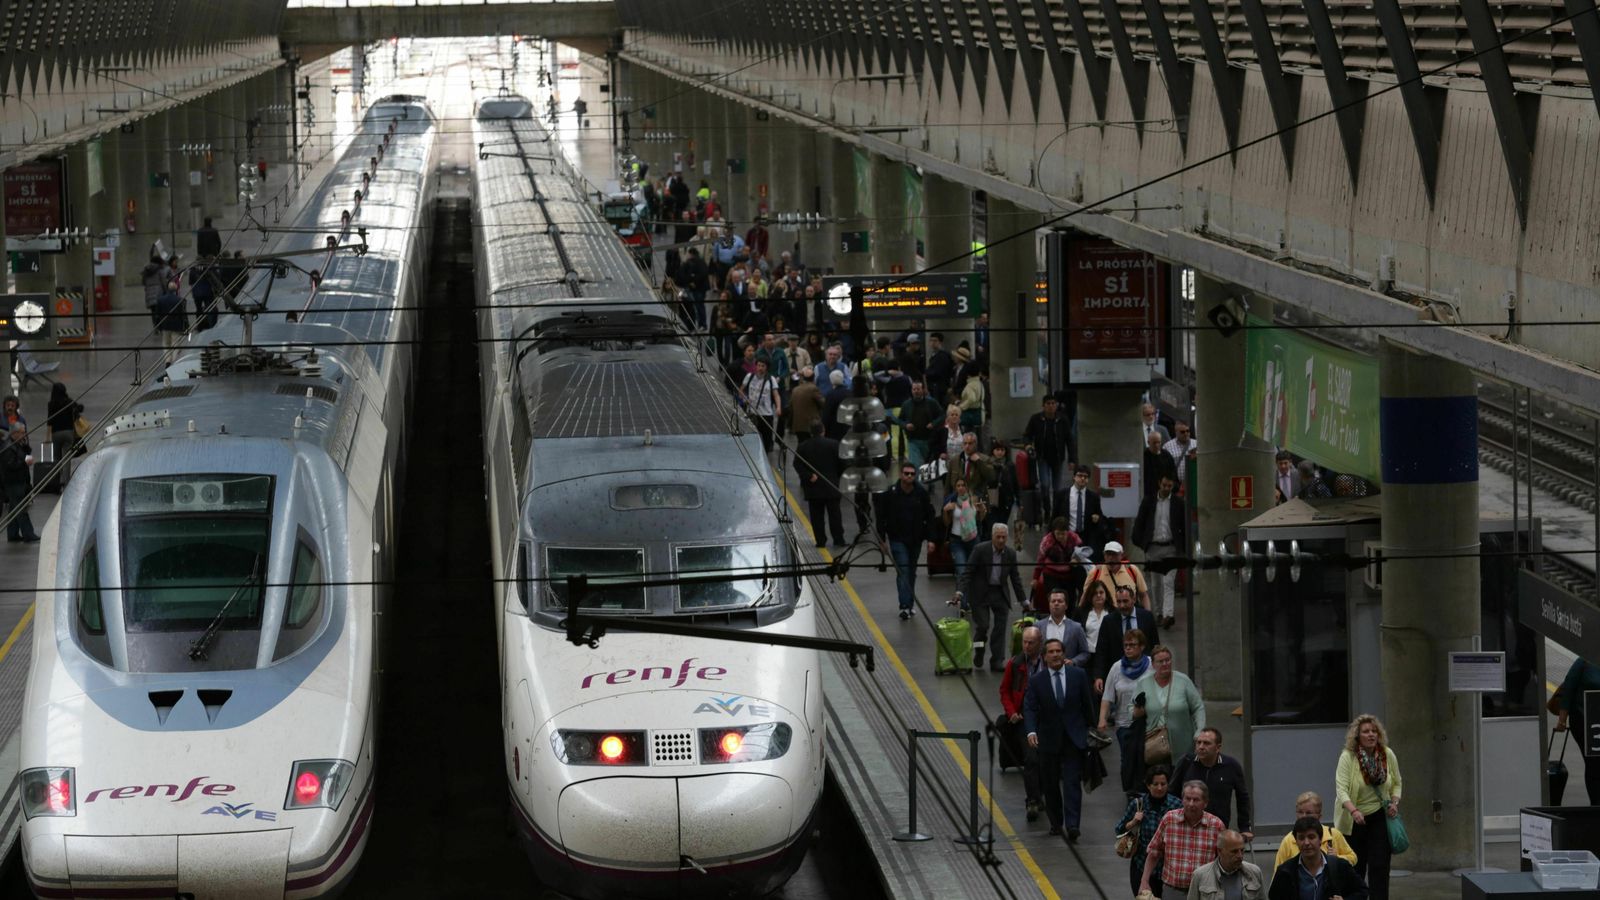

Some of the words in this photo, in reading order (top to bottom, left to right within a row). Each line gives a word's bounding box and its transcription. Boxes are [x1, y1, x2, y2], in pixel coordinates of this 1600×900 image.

[20, 182, 37, 196] SÍ
[8, 197, 50, 206] IMPORTA
[842, 241, 849, 253] 3
[31, 261, 38, 273] 4
[1079, 260, 1093, 270] LA
[1104, 271, 1129, 294] SÍ
[957, 296, 969, 314] 3
[1083, 297, 1150, 309] IMPORTA
[1541, 598, 1556, 624] Sevilla
[1556, 605, 1569, 631] Santa
[1569, 612, 1582, 638] Justa
[580, 657, 728, 689] renfe
[692, 696, 770, 717] AVE
[84, 776, 236, 802] renfe
[200, 801, 277, 822] AVE
